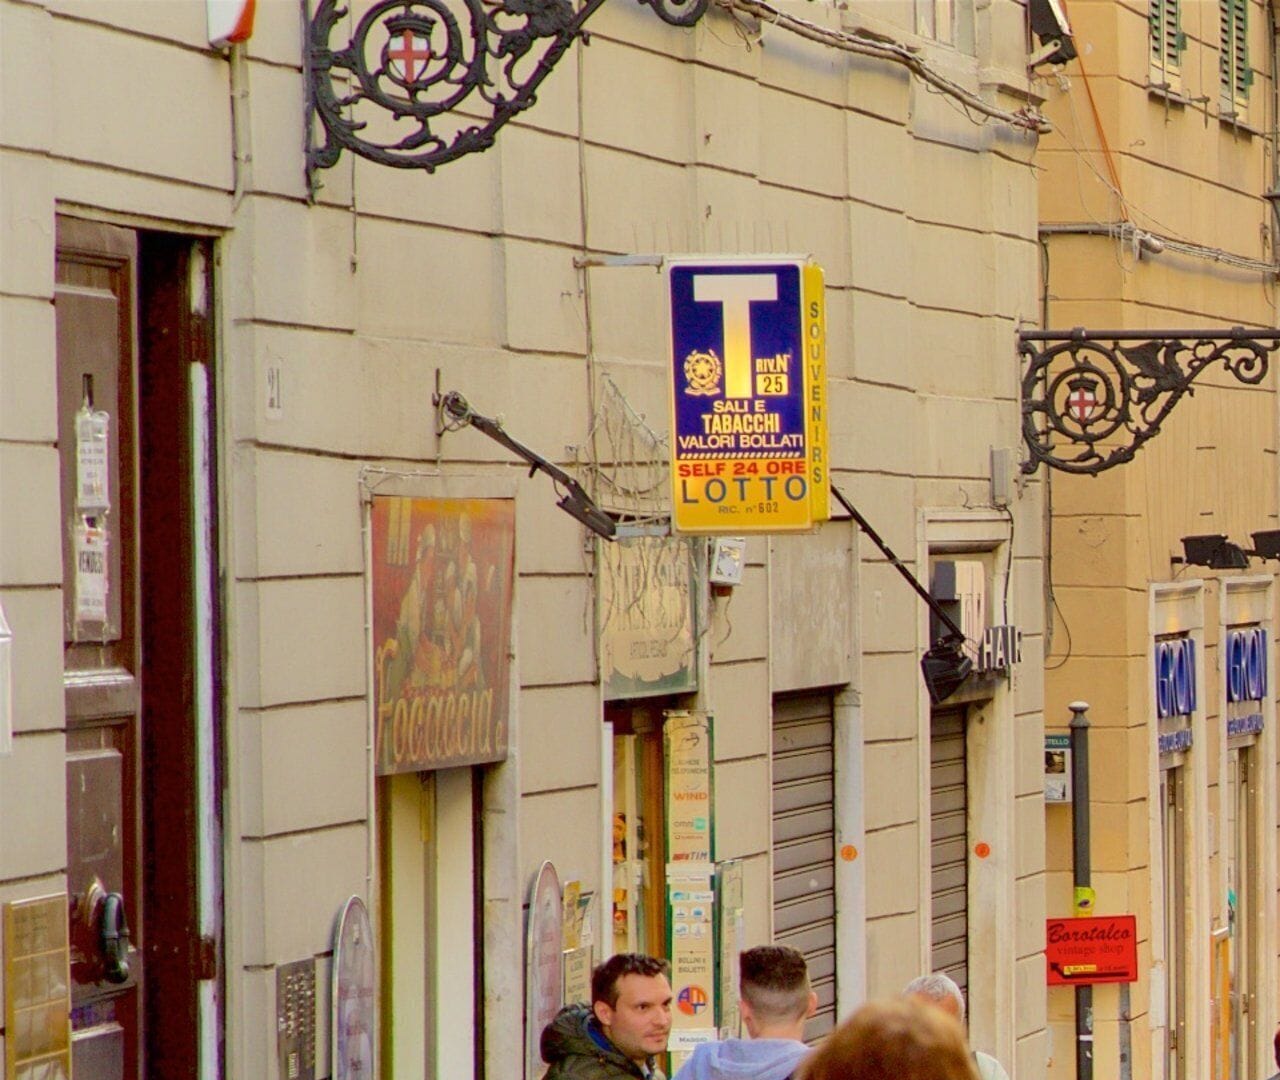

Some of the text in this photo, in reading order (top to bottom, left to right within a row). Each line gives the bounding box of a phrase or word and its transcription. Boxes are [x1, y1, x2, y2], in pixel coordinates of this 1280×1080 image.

[693, 273, 778, 399] T
[763, 375, 784, 394] 25
[809, 301, 823, 485] SOUVENIRS
[713, 400, 767, 413] SALI E
[701, 412, 781, 435] TABACCHI
[678, 433, 804, 450] VALORI BOLLATI
[678, 459, 807, 478] SELF 24 ORE
[681, 474, 808, 504] LOTTO
[718, 504, 741, 514] RIC.
[978, 626, 1022, 669] HAIR
[673, 791, 708, 801] WIND
[1048, 922, 1132, 944] Borotalco
[1099, 943, 1124, 955] shop
